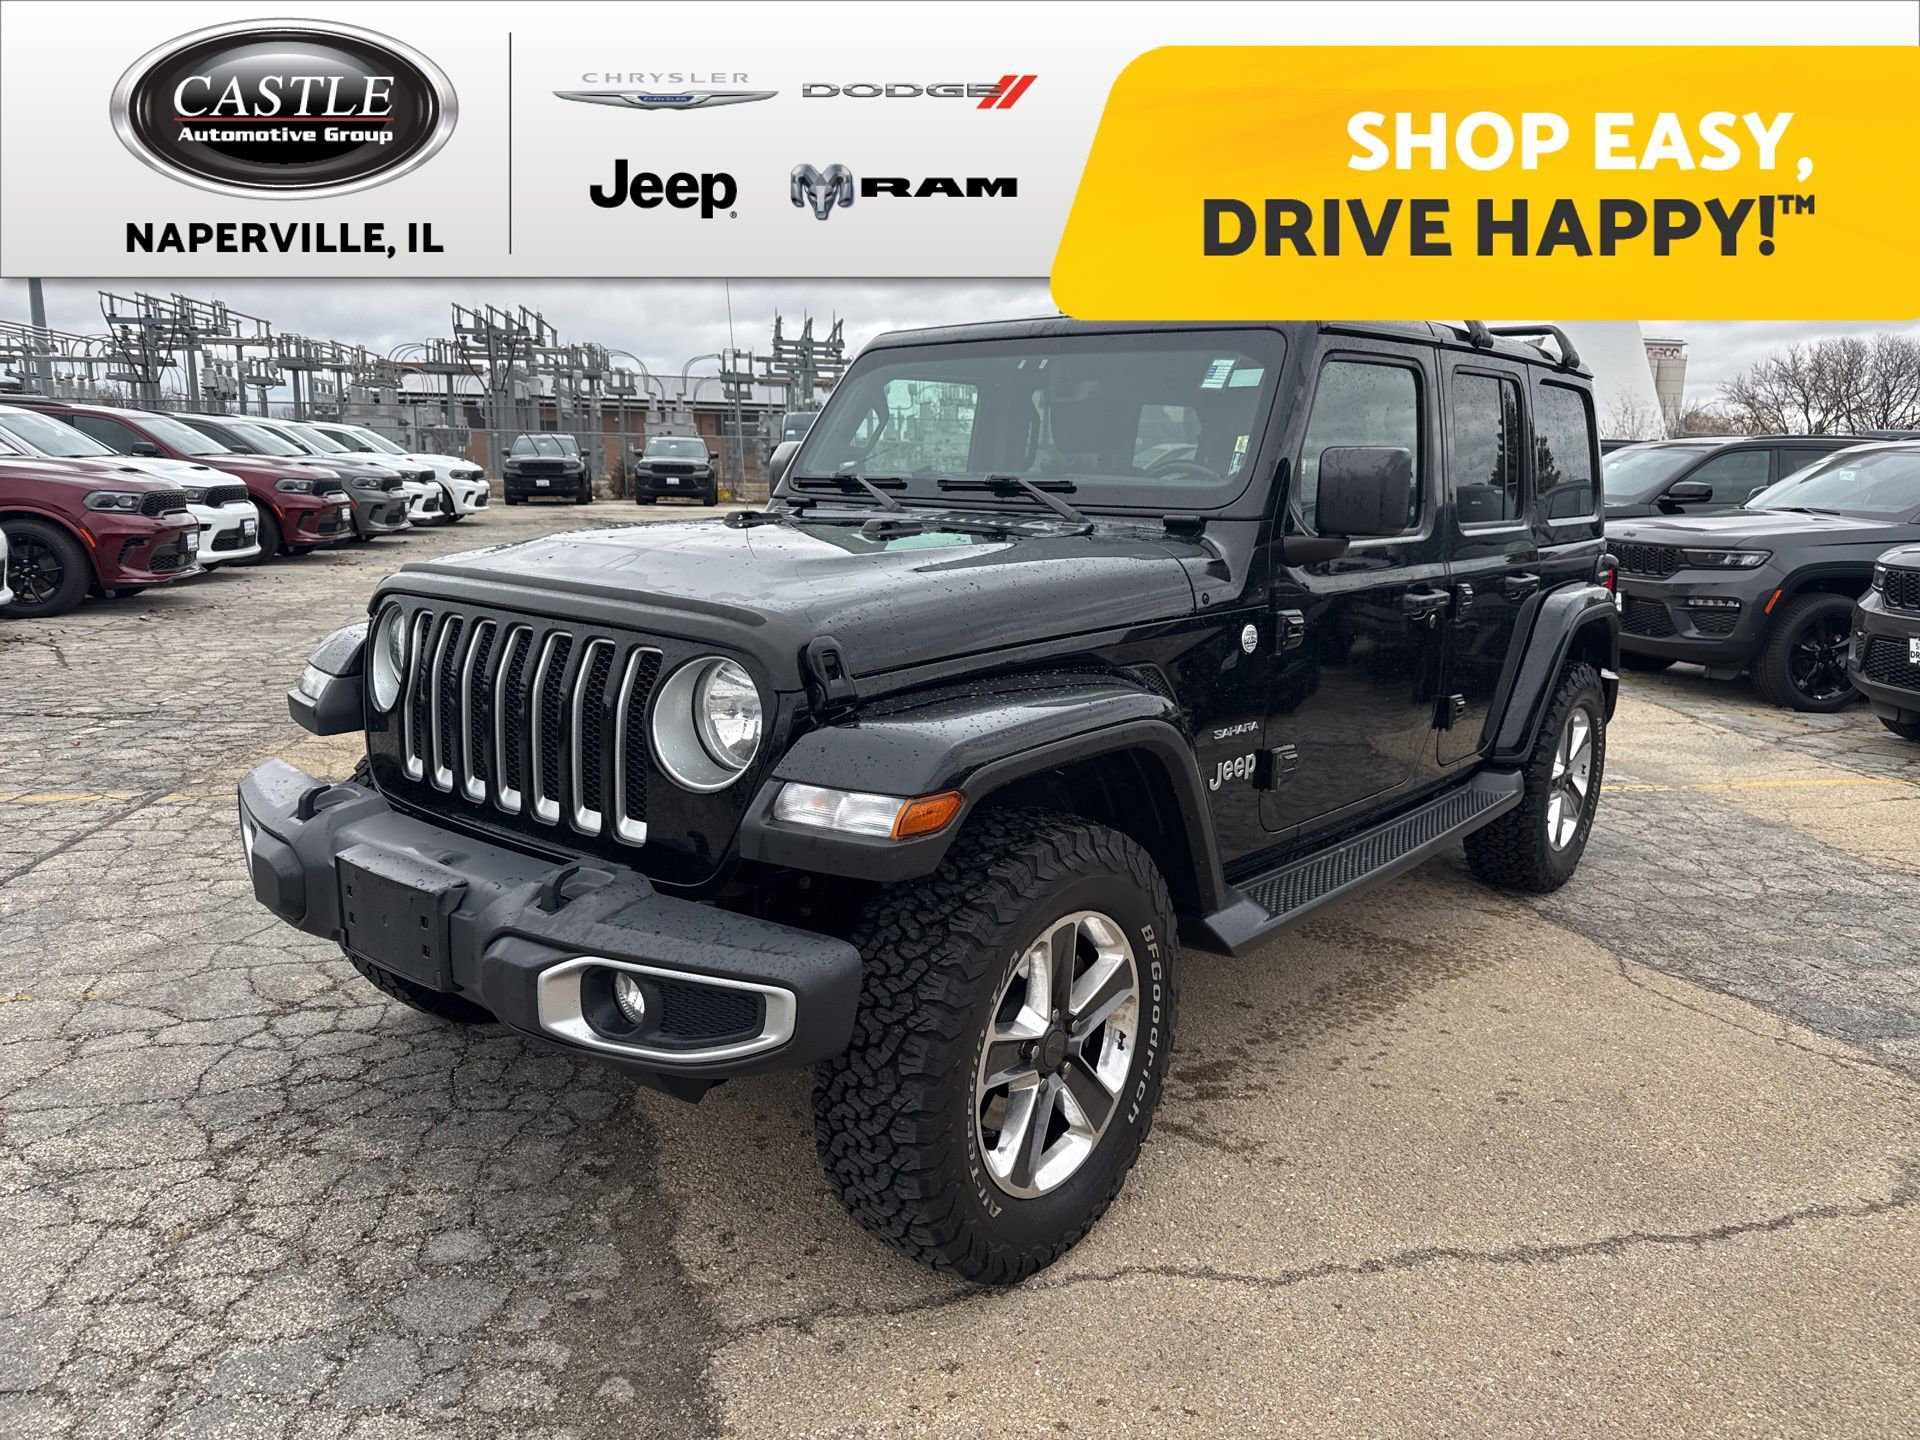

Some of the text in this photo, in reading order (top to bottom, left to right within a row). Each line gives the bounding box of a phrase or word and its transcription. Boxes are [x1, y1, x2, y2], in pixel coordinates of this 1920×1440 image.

[1213, 721, 1259, 739] SAHARA
[1209, 753, 1257, 791] Jeep
[1127, 923, 1162, 1125] BFGoodrich
